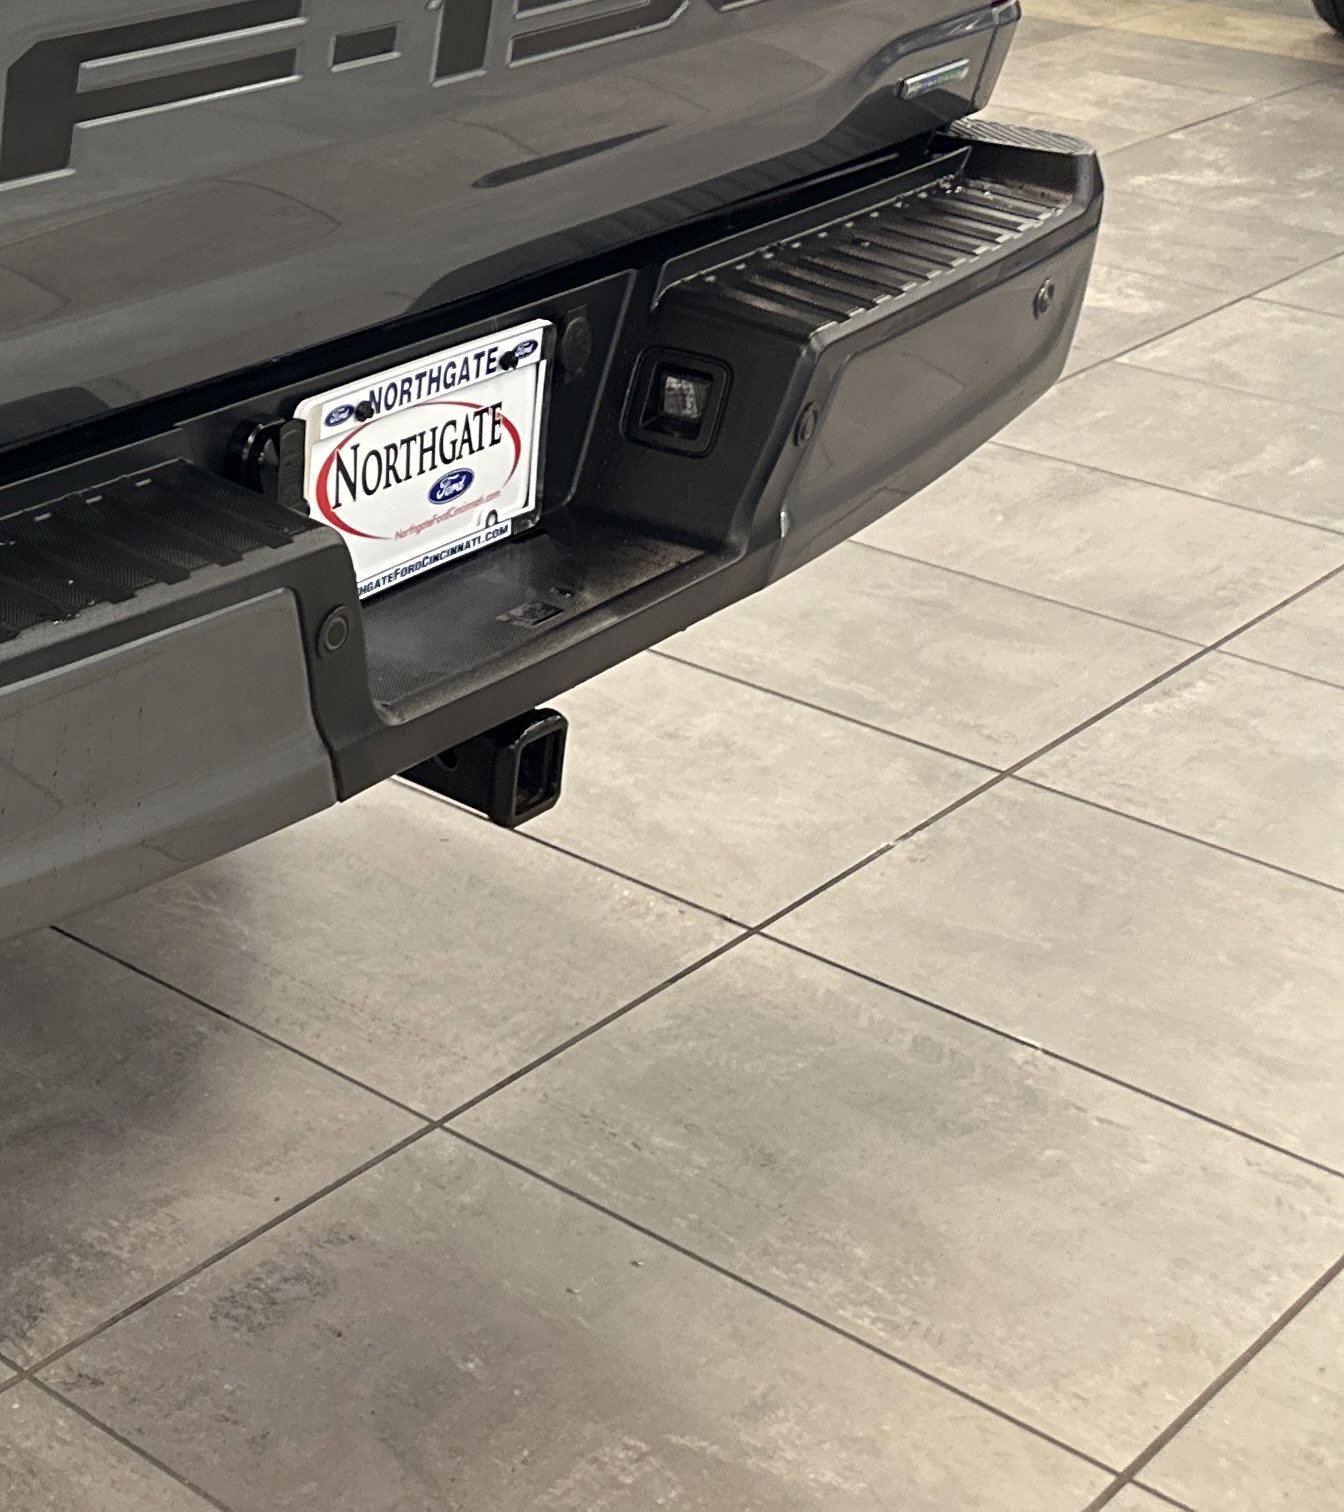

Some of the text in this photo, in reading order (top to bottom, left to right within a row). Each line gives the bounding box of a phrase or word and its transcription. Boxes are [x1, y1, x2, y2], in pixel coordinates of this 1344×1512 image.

[369, 346, 499, 414] NORTHGATE
[332, 401, 504, 510] NORTHGATE
[437, 471, 472, 501] Ford
